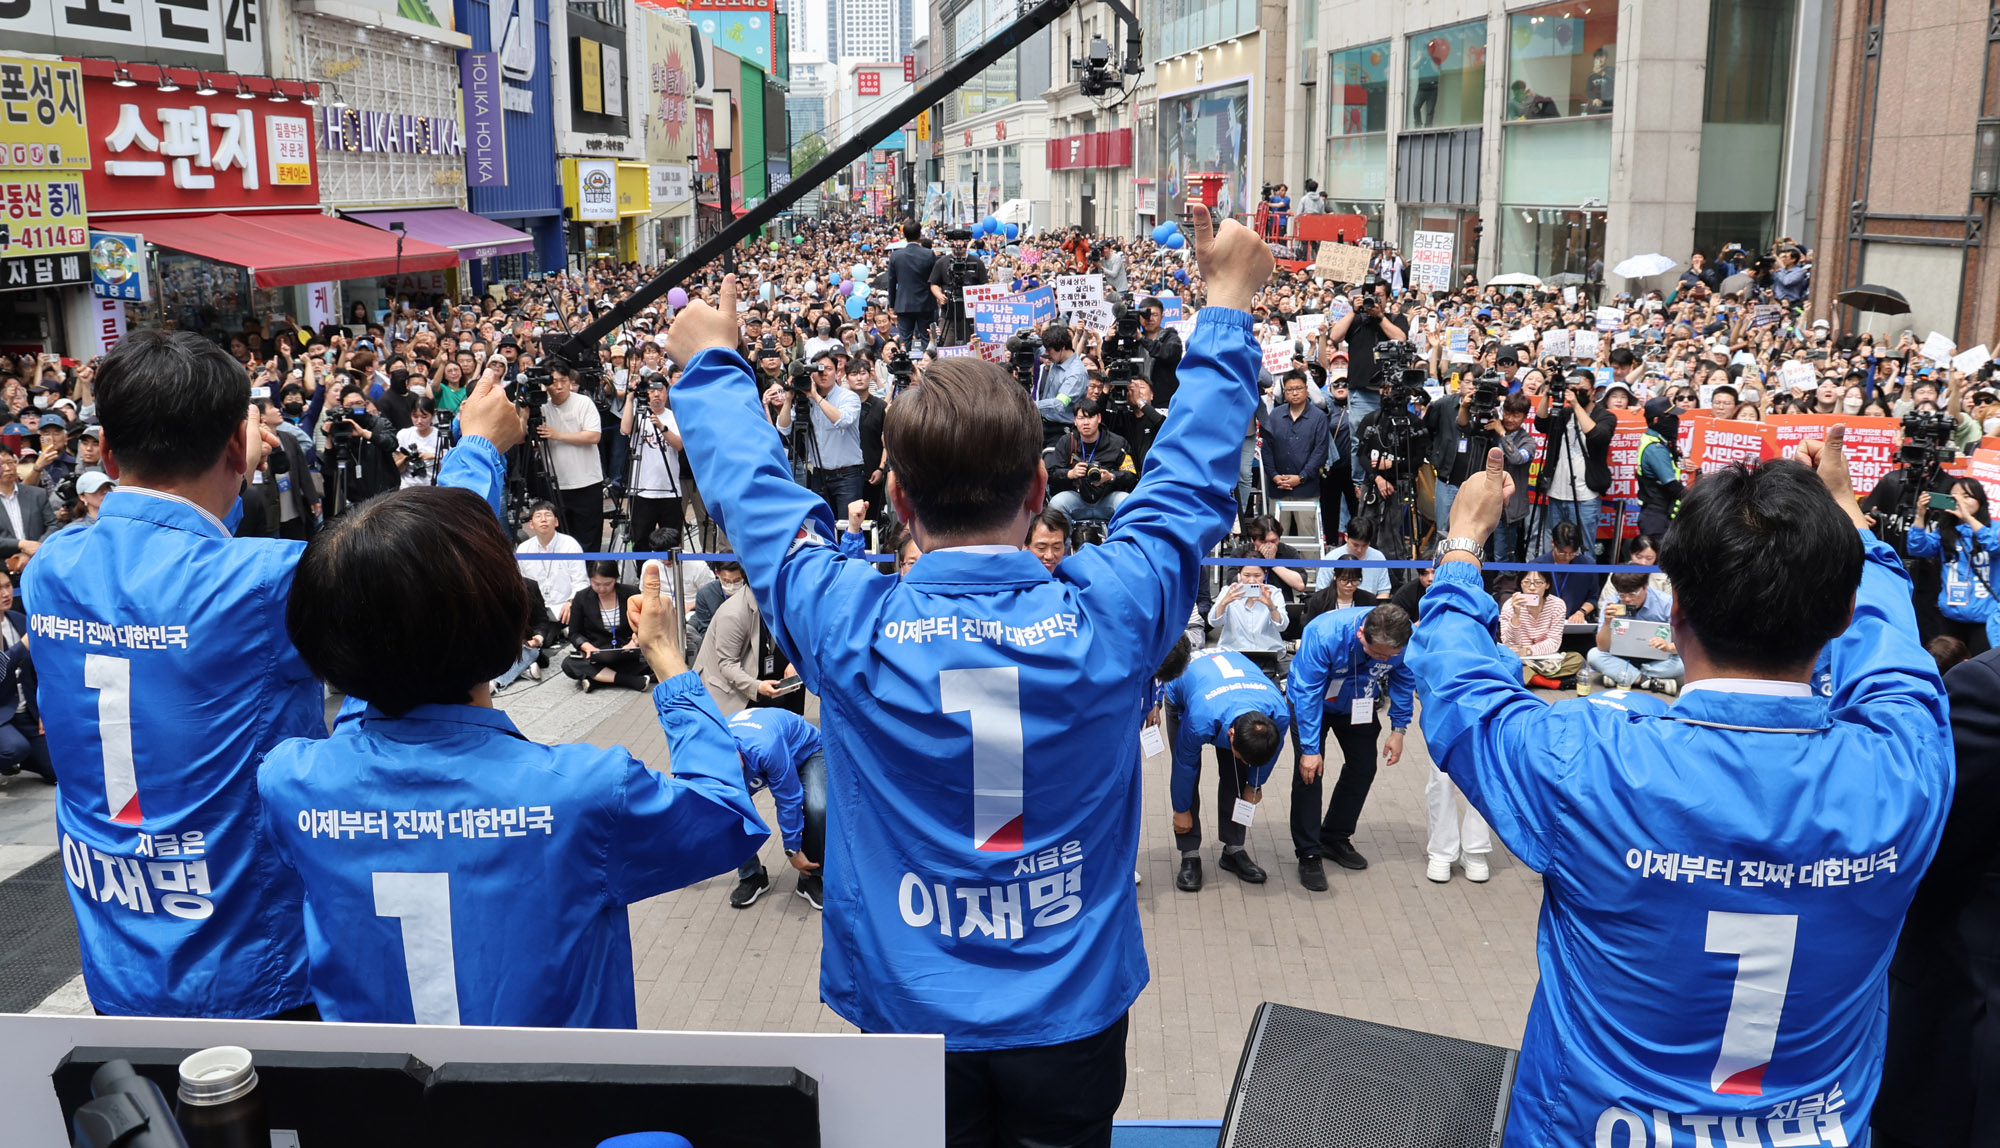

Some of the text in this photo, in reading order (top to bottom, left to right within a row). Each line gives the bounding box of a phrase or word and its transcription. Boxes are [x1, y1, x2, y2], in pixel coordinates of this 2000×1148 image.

[322, 106, 462, 156] HOLIKA HOLIKA
[471, 54, 493, 184] HOLIKA HOLIKA
[105, 103, 259, 190] 스편지
[280, 143, 304, 157] 전문점
[280, 167, 309, 181] 폰케이스
[48, 183, 81, 217] 중개
[600, 207, 614, 215] Shop
[1414, 233, 1453, 250] 경남도청
[387, 275, 443, 290] SALE
[1060, 279, 1087, 287] 영세상인
[1060, 293, 1088, 302] 조례안을
[992, 315, 1029, 325] 영세상인
[1704, 429, 1762, 450] 장애인도
[1843, 445, 1891, 461] 누구나
[31, 614, 189, 650] 이제부터 진짜 대한민국
[885, 613, 1078, 647] 이제부터 진짜 대한민국
[84, 653, 143, 826] 1
[939, 666, 1024, 852] 1
[298, 805, 554, 840] 이제부터 진짜 대한민국
[135, 831, 206, 858] 지금은
[1013, 840, 1084, 878] 지금은
[62, 832, 214, 920] 이재명
[1626, 845, 1899, 889] 이제부터 진짜 대한민국
[898, 863, 1084, 940] 이재명
[372, 872, 461, 1025] 1
[1704, 910, 1799, 1097] 1
